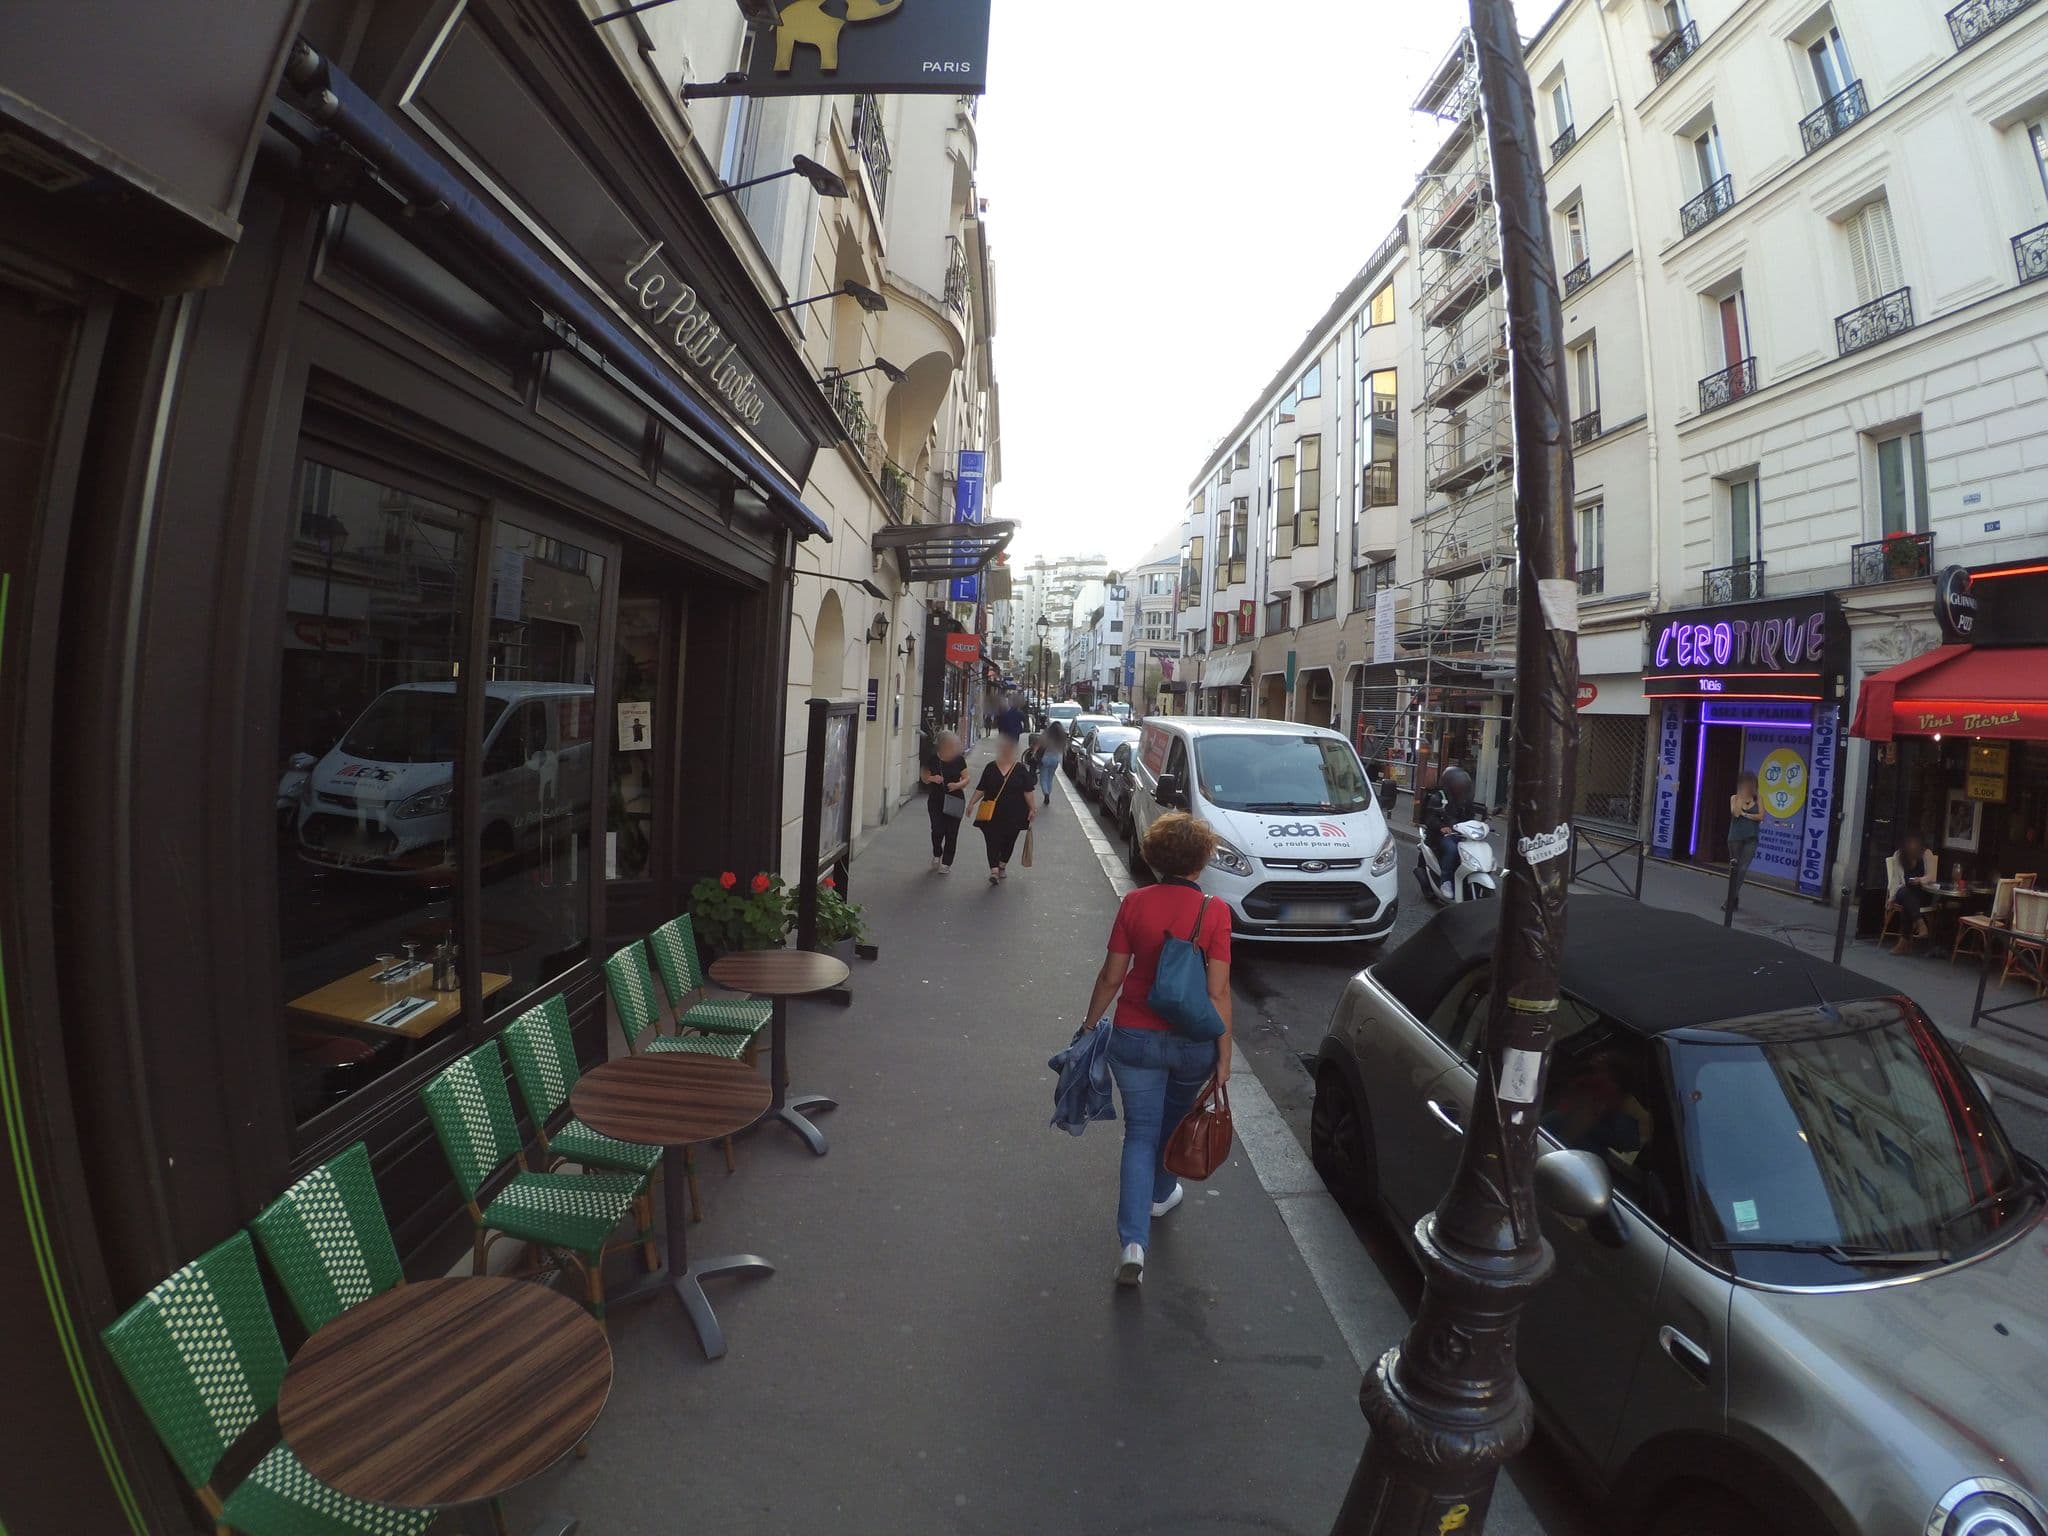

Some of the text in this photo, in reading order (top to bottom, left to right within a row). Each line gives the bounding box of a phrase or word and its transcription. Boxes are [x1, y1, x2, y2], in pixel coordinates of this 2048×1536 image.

[922, 61, 971, 73] PARIS
[624, 240, 666, 310] Le
[653, 282, 721, 368] Petit
[1950, 592, 1977, 609] GUINN
[1655, 611, 1826, 671] L'EROTIQUE
[1917, 713, 1955, 731] Vins
[1267, 822, 1321, 837] ada
[1764, 852, 1802, 868] DISCOU
[1802, 827, 1826, 881] VIDEO
